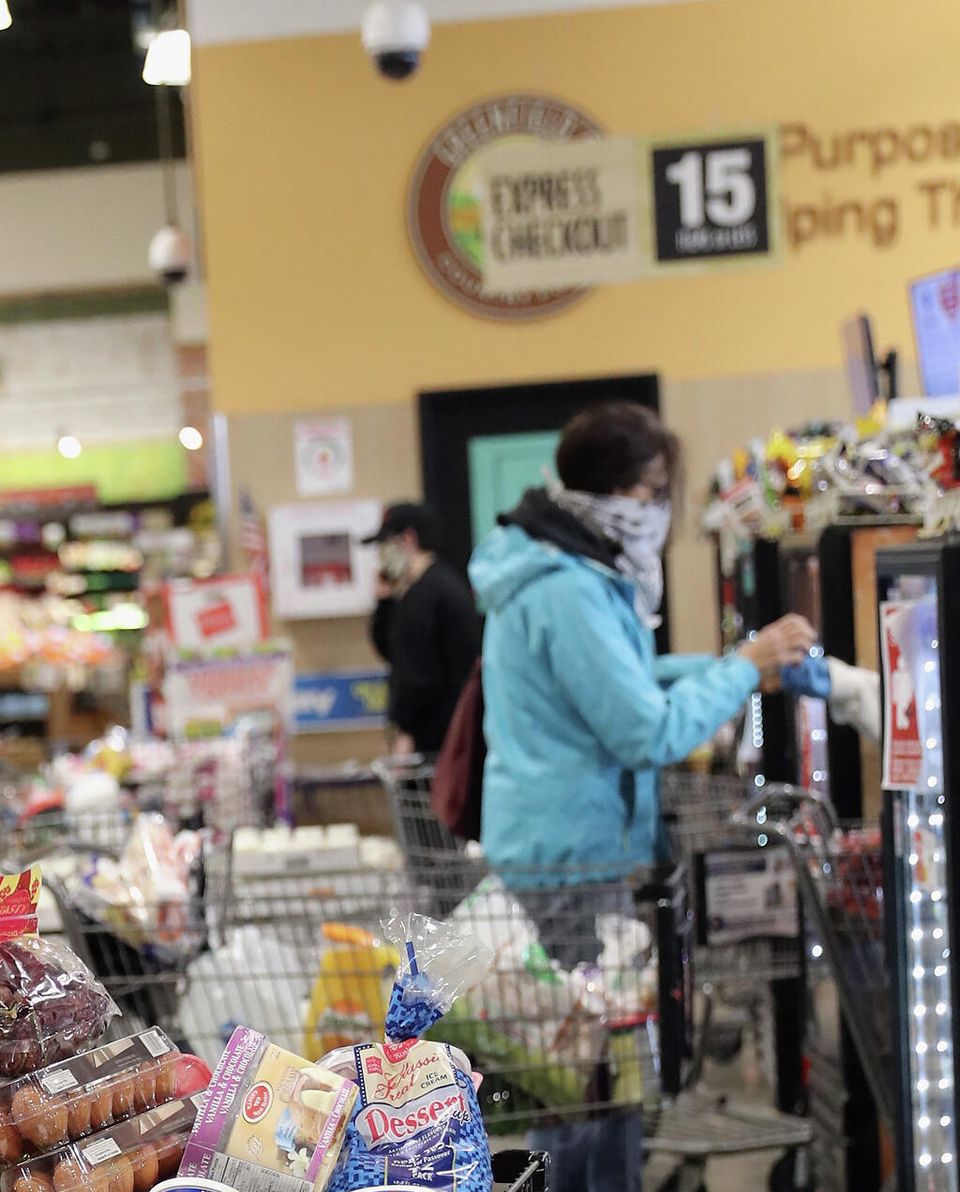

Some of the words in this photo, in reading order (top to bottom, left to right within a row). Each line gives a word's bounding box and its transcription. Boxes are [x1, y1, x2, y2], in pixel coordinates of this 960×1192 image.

[491, 168, 601, 217] EXPRESS
[665, 148, 757, 228] 15
[491, 211, 628, 262] CHECKOUT
[204, 1087, 224, 1124] VANILLA
[223, 1044, 244, 1081] CHOCOLATE
[420, 1074, 448, 1089] CREAM
[426, 1071, 439, 1080] ICE
[219, 1083, 239, 1116] VANILLA
[423, 1150, 451, 1163] Passover
